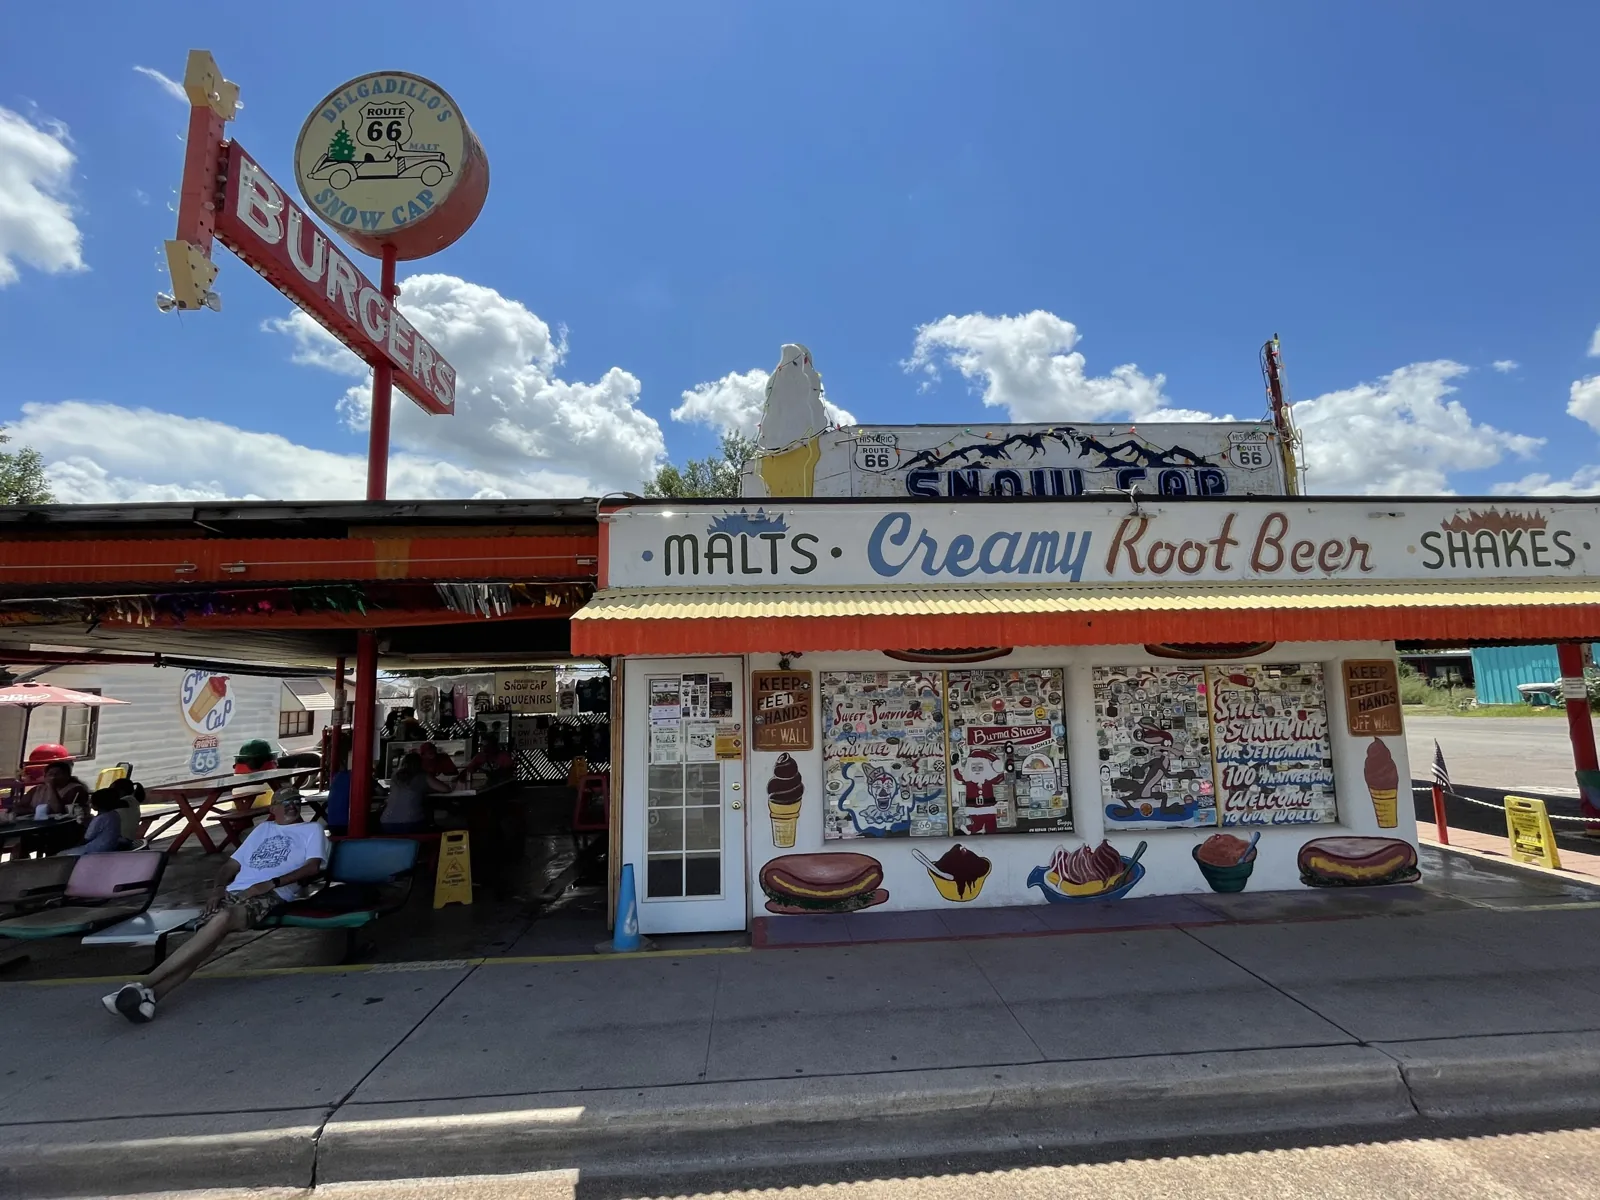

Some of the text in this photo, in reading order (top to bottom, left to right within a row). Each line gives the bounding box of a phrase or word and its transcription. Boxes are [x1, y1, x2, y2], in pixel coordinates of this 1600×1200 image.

[321, 78, 453, 124] DELGADILLO'S
[367, 107, 406, 116] ROUTE
[367, 120, 402, 142] 66
[408, 143, 441, 151] MALT
[313, 188, 436, 230] SNOW CAP
[236, 155, 455, 406] BURGERS
[860, 435, 892, 443] HISTORIC
[865, 454, 888, 468] 66
[1240, 452, 1262, 466] 66
[906, 468, 1229, 496] SNOW CAP
[664, 533, 819, 576] MALTS
[868, 511, 1375, 582] Creamy Root Beer
[1420, 530, 1577, 570] SHAKES
[1349, 666, 1388, 678] KEEP
[504, 681, 528, 690] SNOW
[760, 677, 800, 690] KEEP
[1349, 681, 1380, 698] FEET
[498, 694, 552, 705] SOUVENIRS
[758, 692, 792, 710] FEET
[1214, 691, 1262, 723] STILL
[1359, 692, 1396, 712] HANDS
[206, 700, 232, 730] Cap
[764, 705, 808, 724] HANDS
[834, 702, 924, 726] SWEET SURVIVOR
[1352, 714, 1397, 730] OFF WAL
[780, 728, 808, 743] WALL
[973, 727, 1042, 744] Burma Shave
[1224, 718, 1327, 743] SURVIVING
[196, 740, 217, 749] ROUTE
[1216, 744, 1243, 762] FOR
[195, 752, 216, 770] 66
[1224, 764, 1256, 789] 100
[1258, 770, 1334, 786] ANNIVERSARY
[1226, 790, 1314, 811] WELCOME
[1224, 812, 1239, 825] TO
[1272, 810, 1322, 824] WORLD
